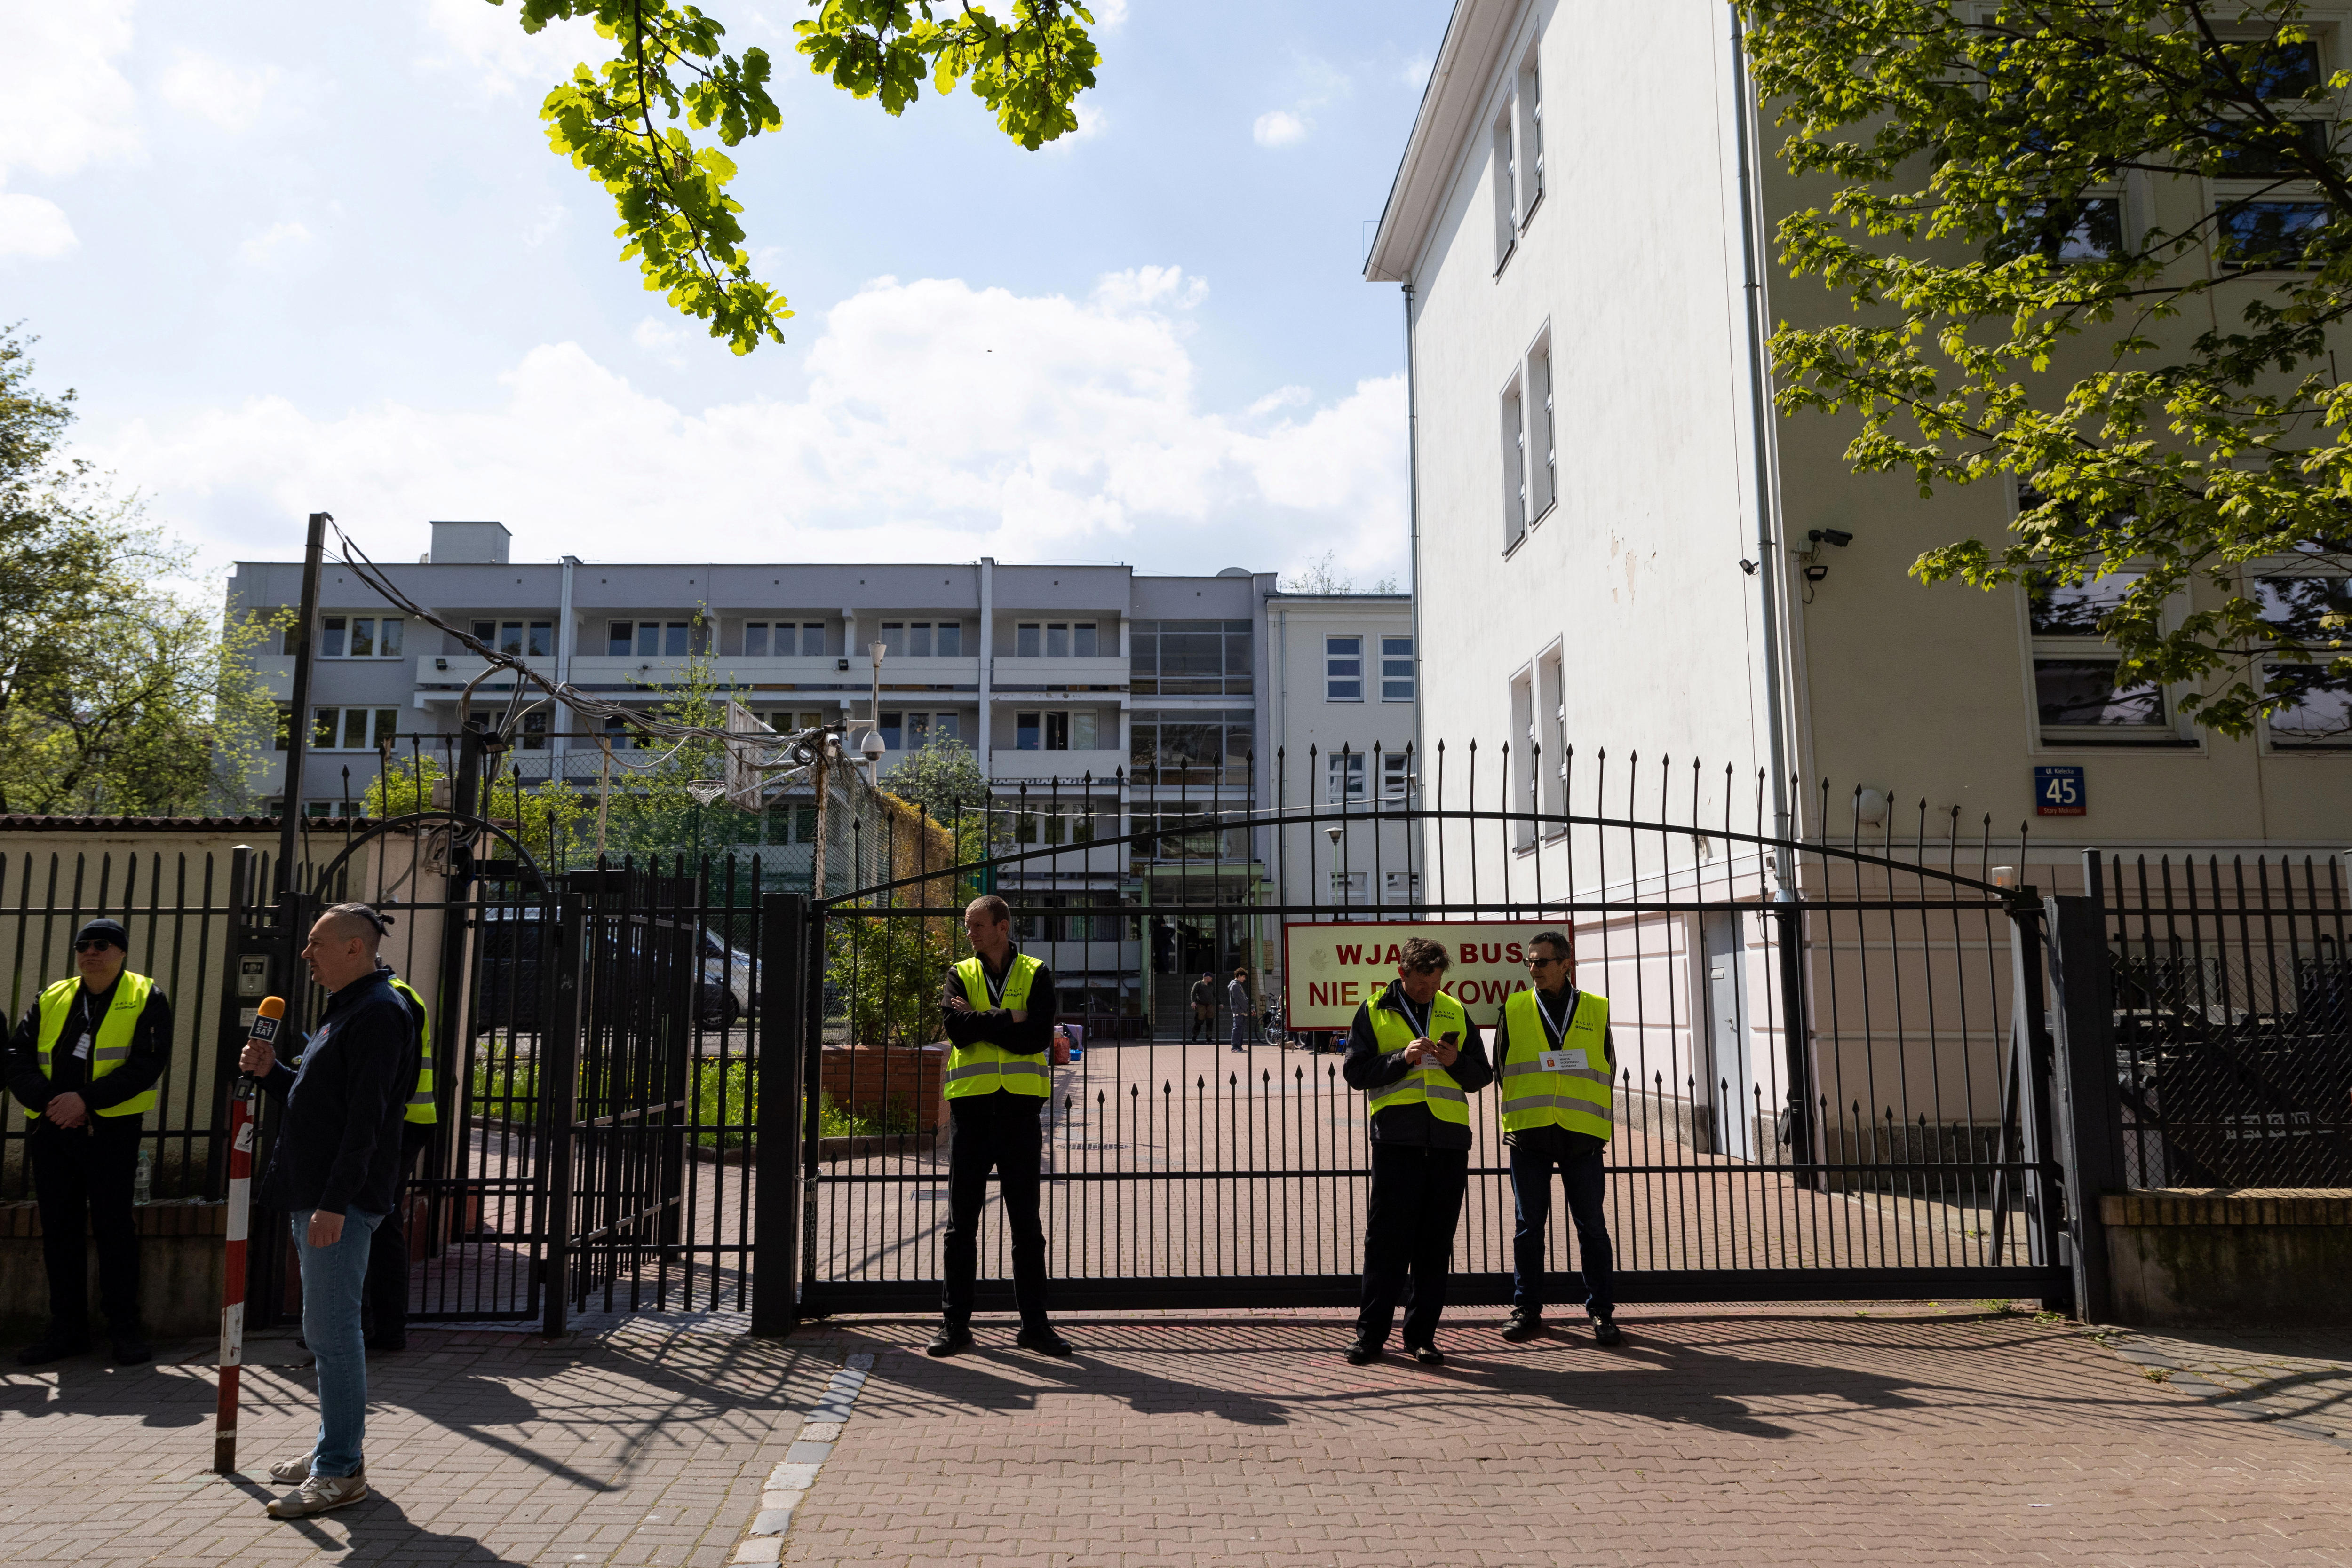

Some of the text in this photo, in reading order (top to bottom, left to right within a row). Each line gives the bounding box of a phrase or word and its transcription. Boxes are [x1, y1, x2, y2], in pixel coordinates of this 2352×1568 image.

[2046, 778, 2076, 804] 45
[1460, 942, 1524, 964] BUS
[1309, 980, 1529, 1006] NIE PKOWA
[255, 1027, 272, 1036] SAT
[257, 1020, 273, 1029] BEL
